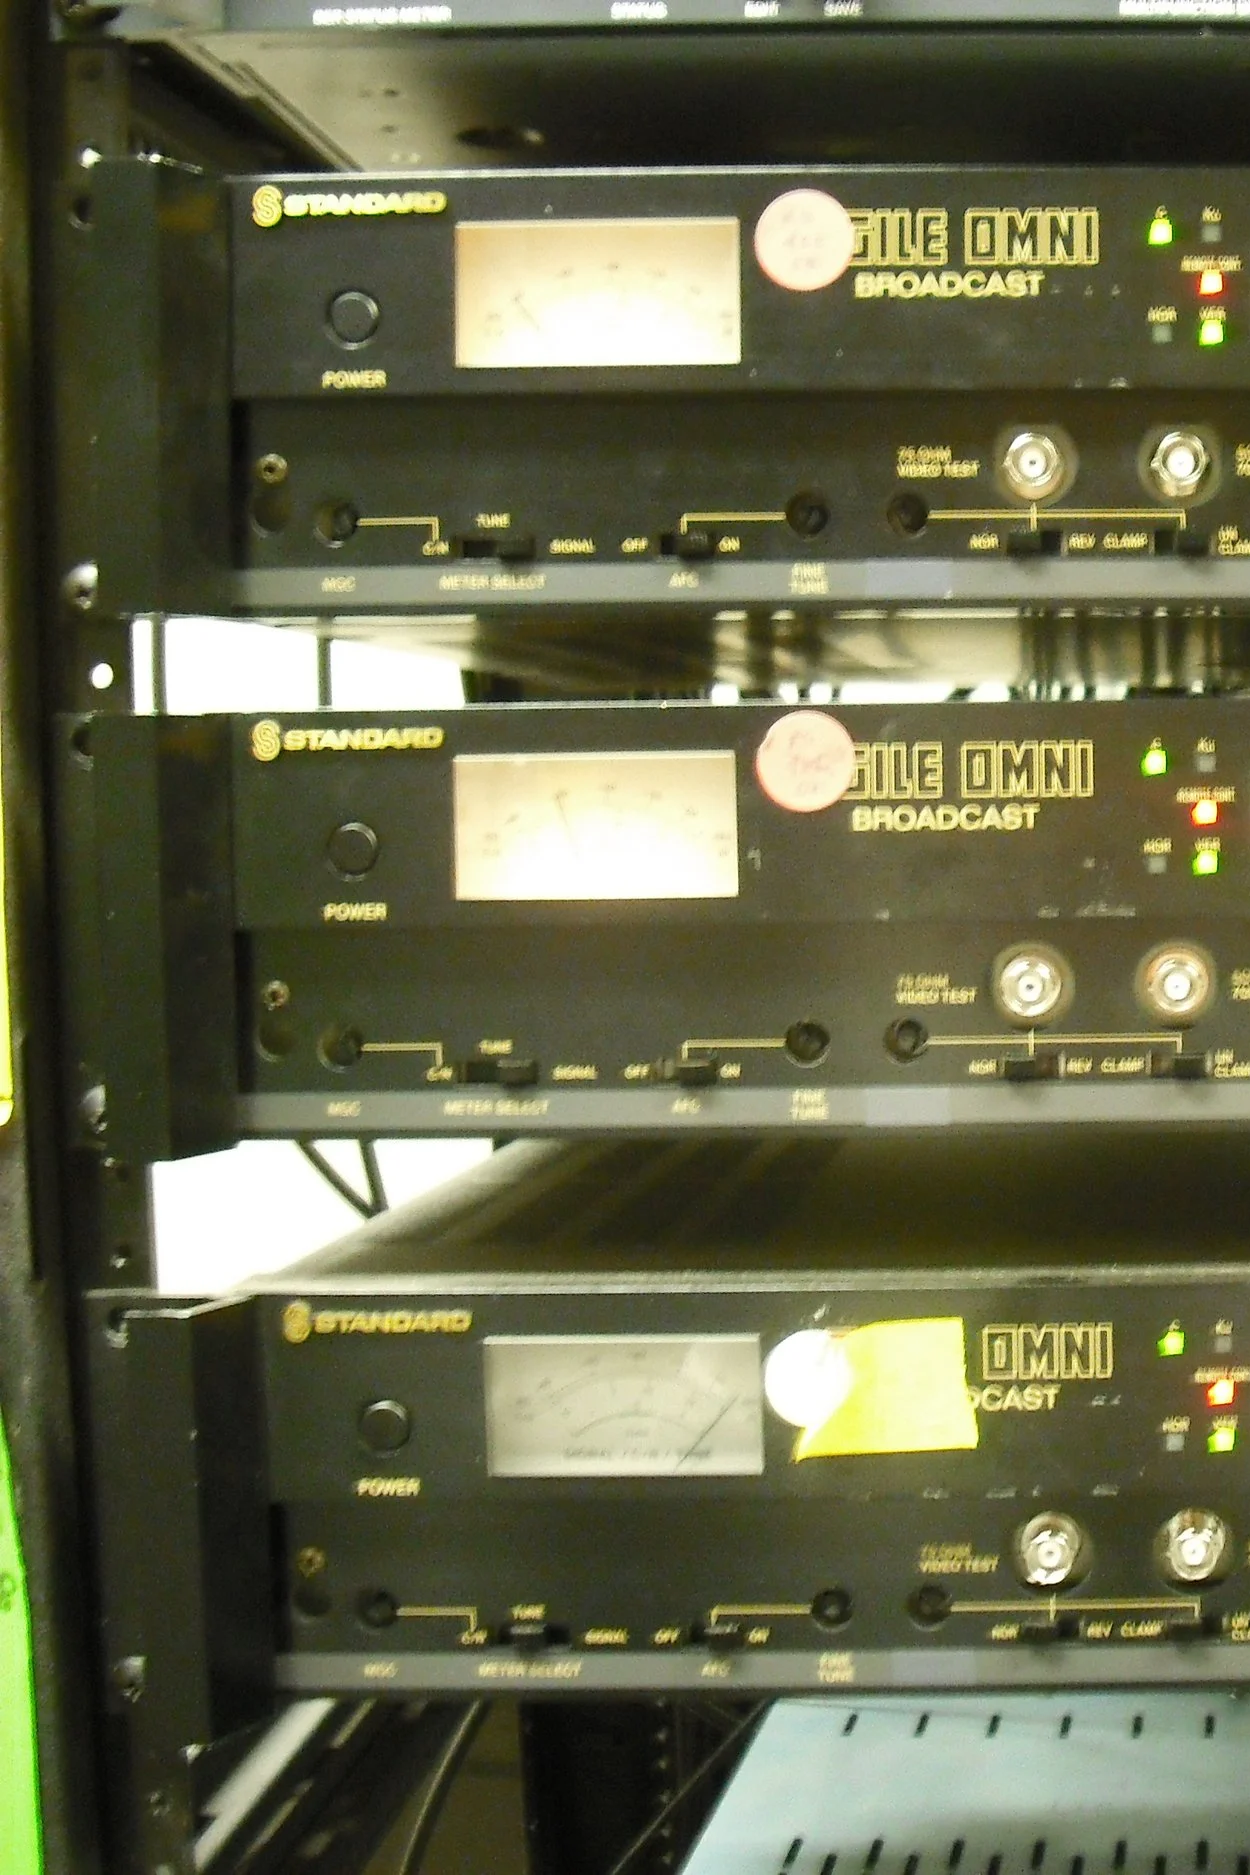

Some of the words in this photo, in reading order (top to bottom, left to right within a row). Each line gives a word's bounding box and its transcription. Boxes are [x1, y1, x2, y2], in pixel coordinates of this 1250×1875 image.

[282, 191, 447, 217] STANDARD
[964, 207, 1100, 265] OMNI
[854, 270, 1046, 298] BROADCAST
[283, 727, 444, 752] STANDARD
[961, 740, 1094, 799] OMNI
[852, 802, 1040, 832] BROADCAST
[313, 1309, 473, 1333] STANDARD
[982, 1322, 1113, 1380] OMNI
